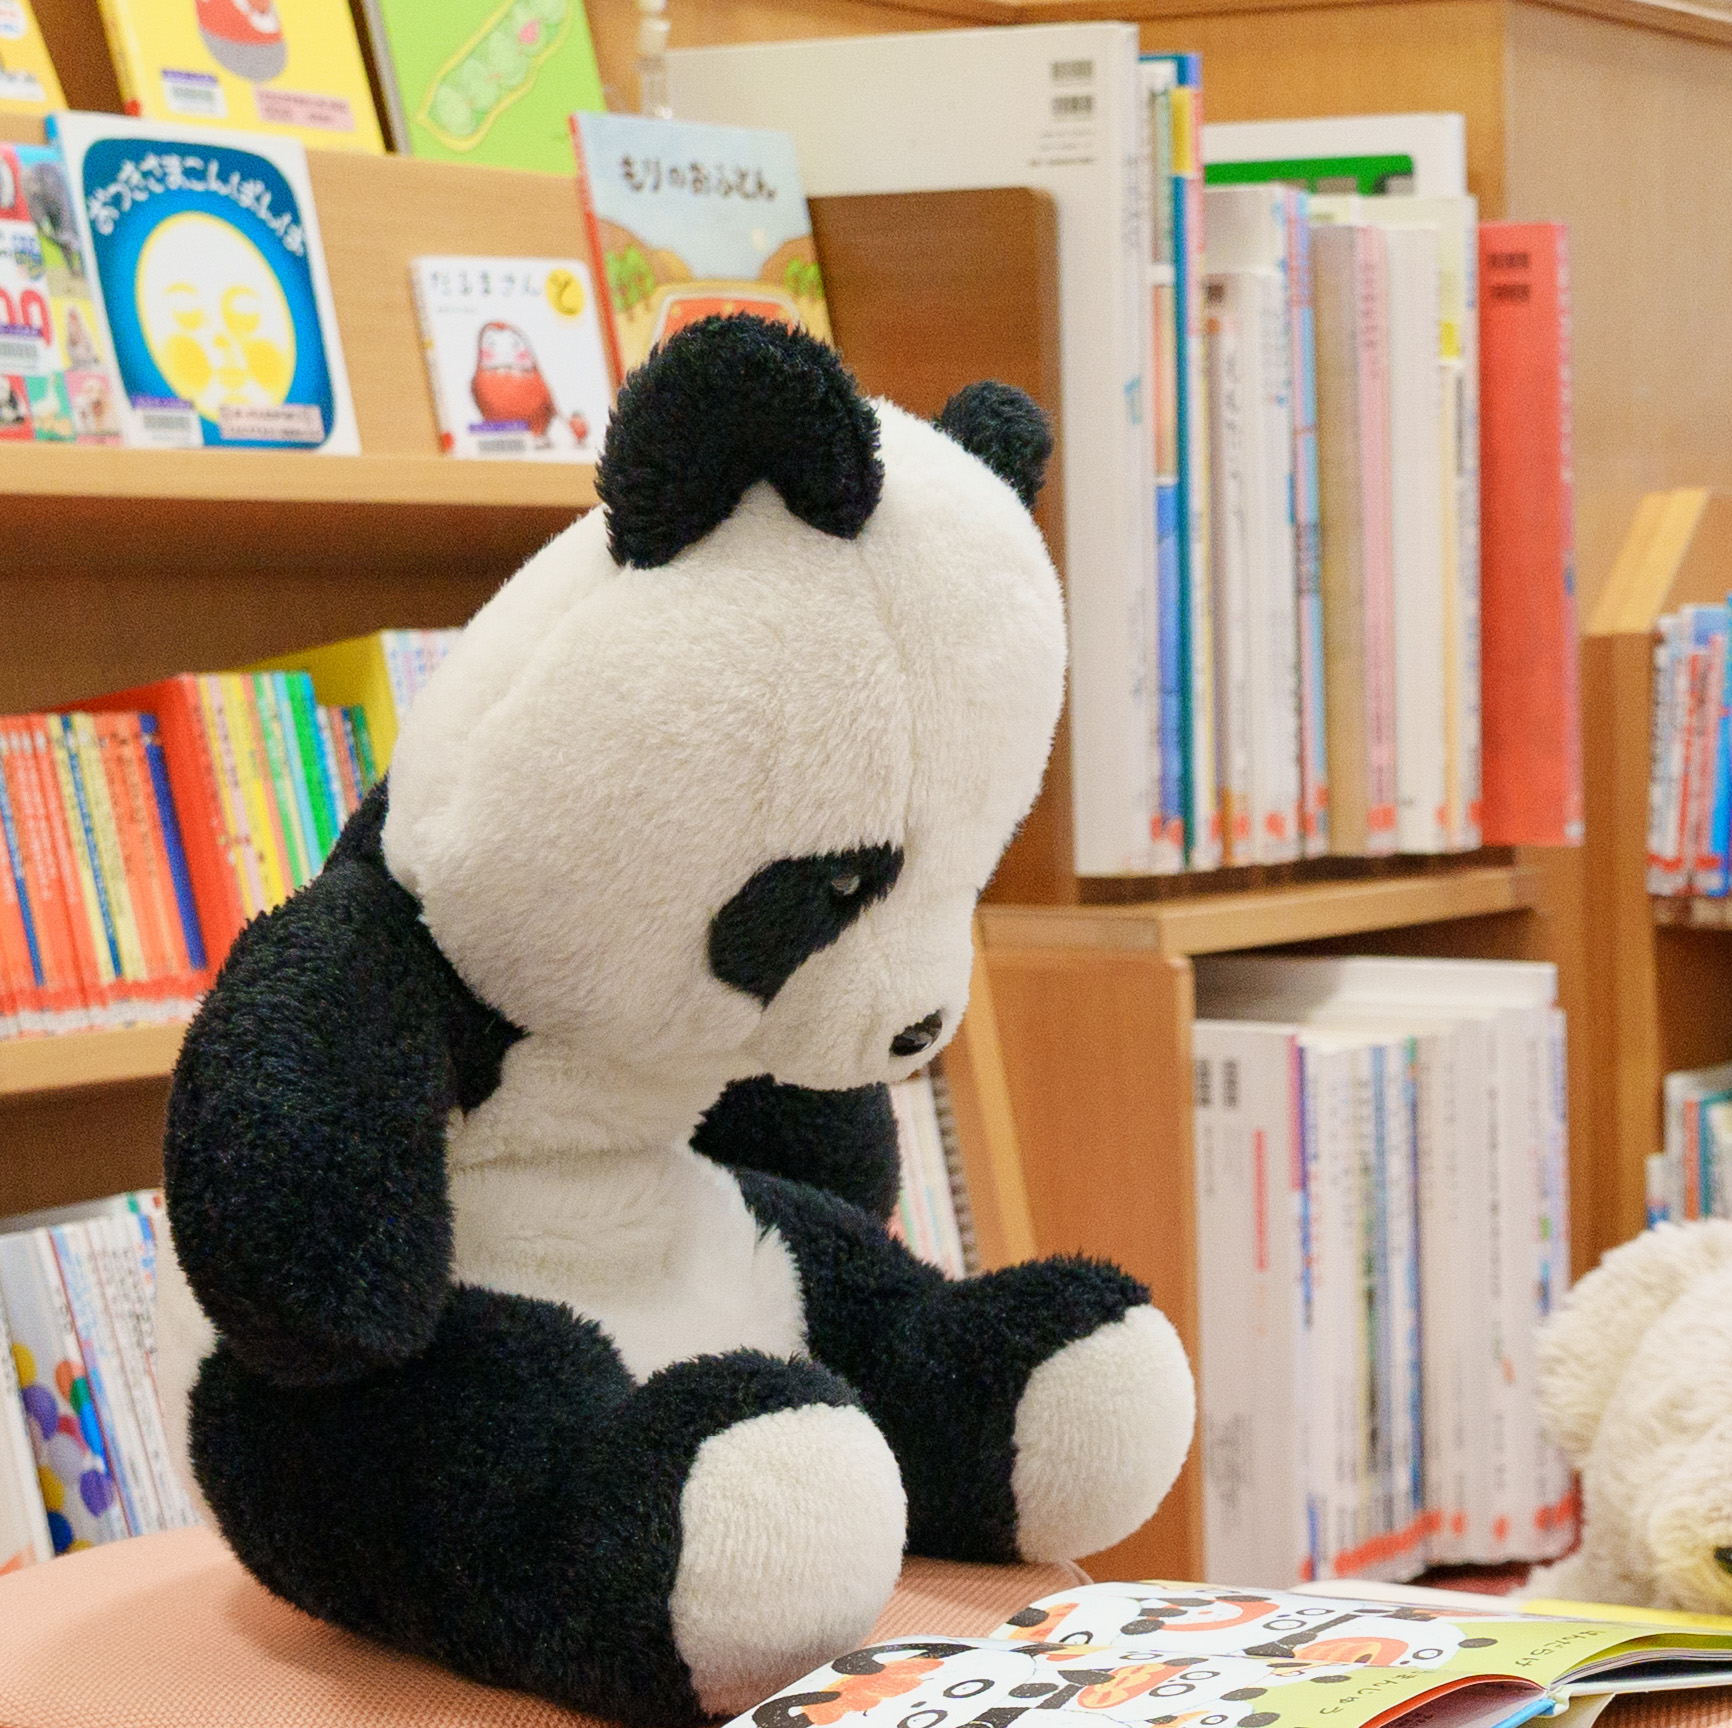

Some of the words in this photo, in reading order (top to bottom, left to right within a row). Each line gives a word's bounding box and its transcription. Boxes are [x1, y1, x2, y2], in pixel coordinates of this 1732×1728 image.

[620, 154, 778, 200] もりのおふとん
